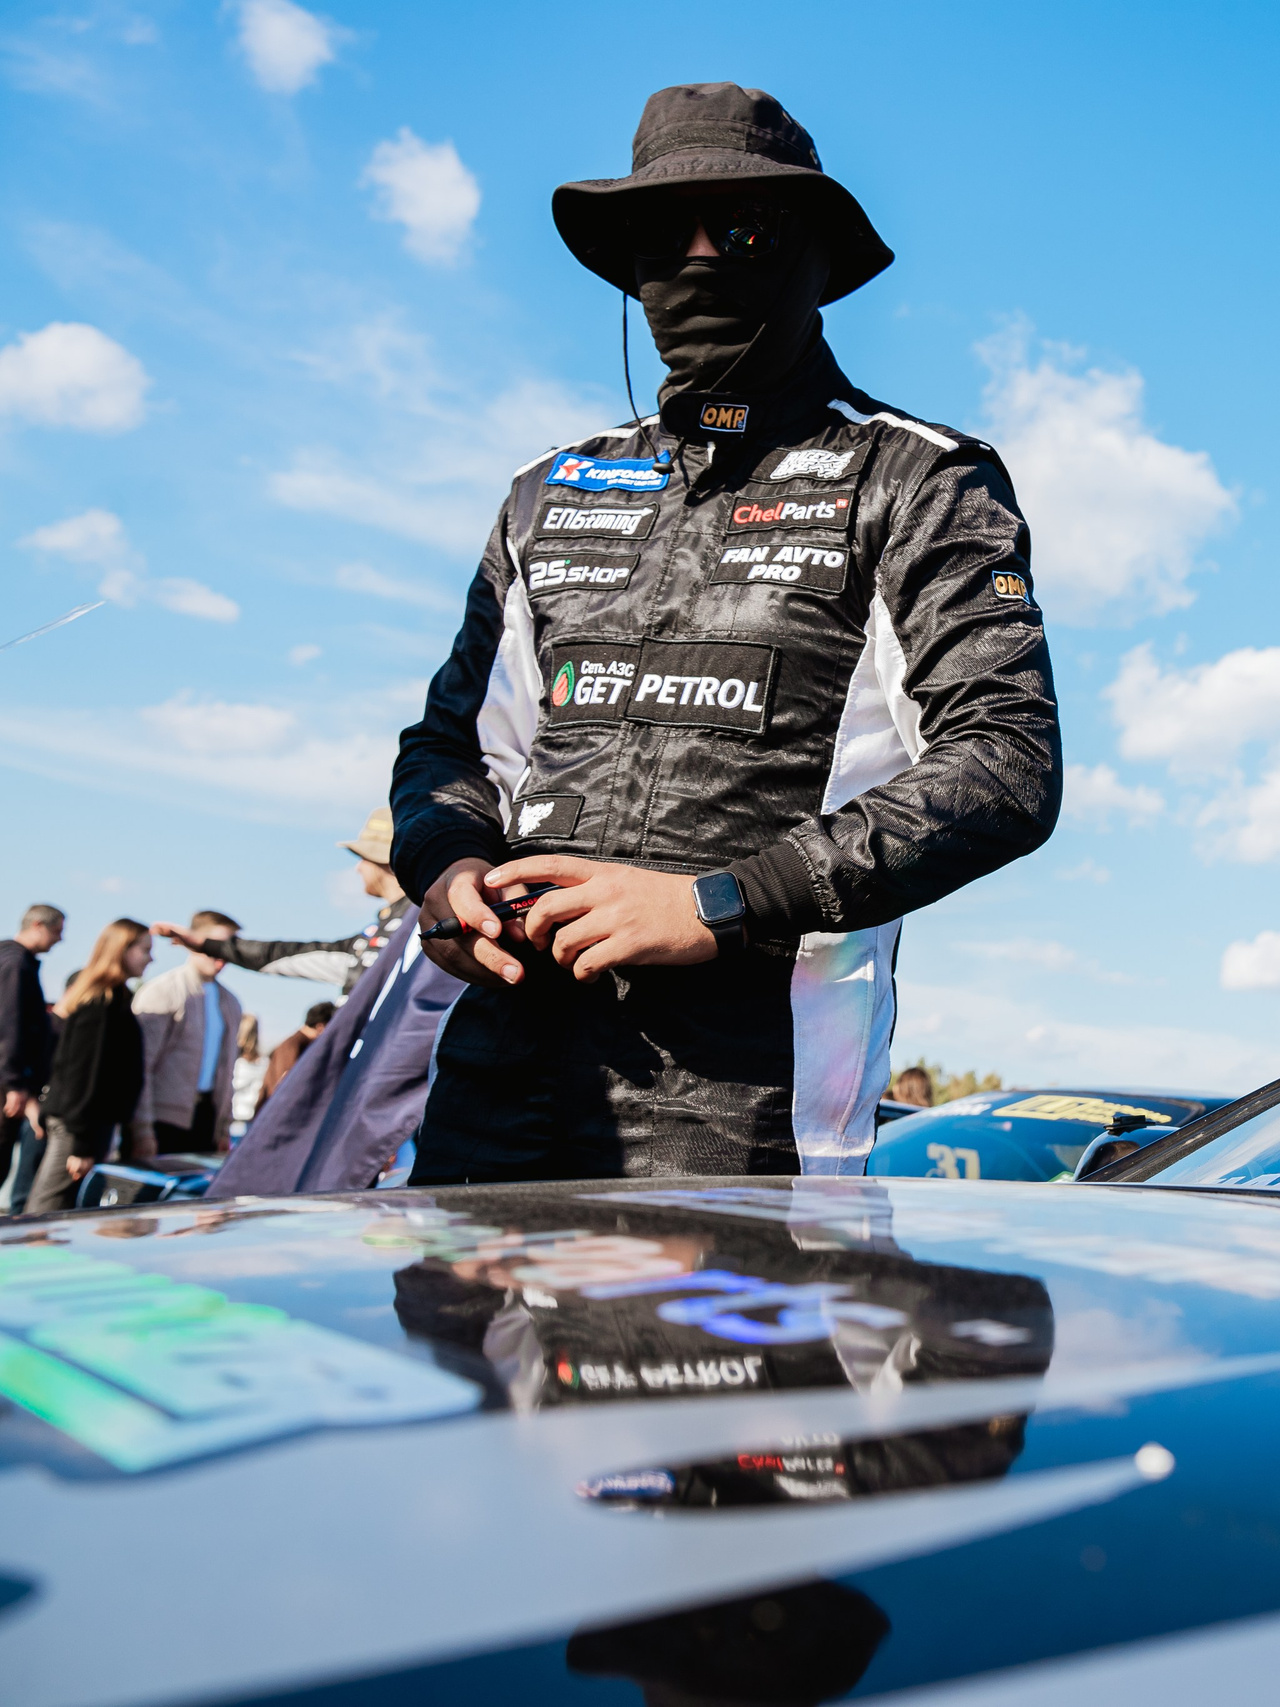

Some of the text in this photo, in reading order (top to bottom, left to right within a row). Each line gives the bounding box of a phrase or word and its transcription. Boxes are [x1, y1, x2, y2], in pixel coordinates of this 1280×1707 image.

[733, 501, 835, 523] ChelParts
[720, 546, 844, 568] FAN AVTO
[747, 564, 801, 581] PRO
[581, 661, 605, 674] Сеть
[574, 674, 763, 712] GET PETROL
